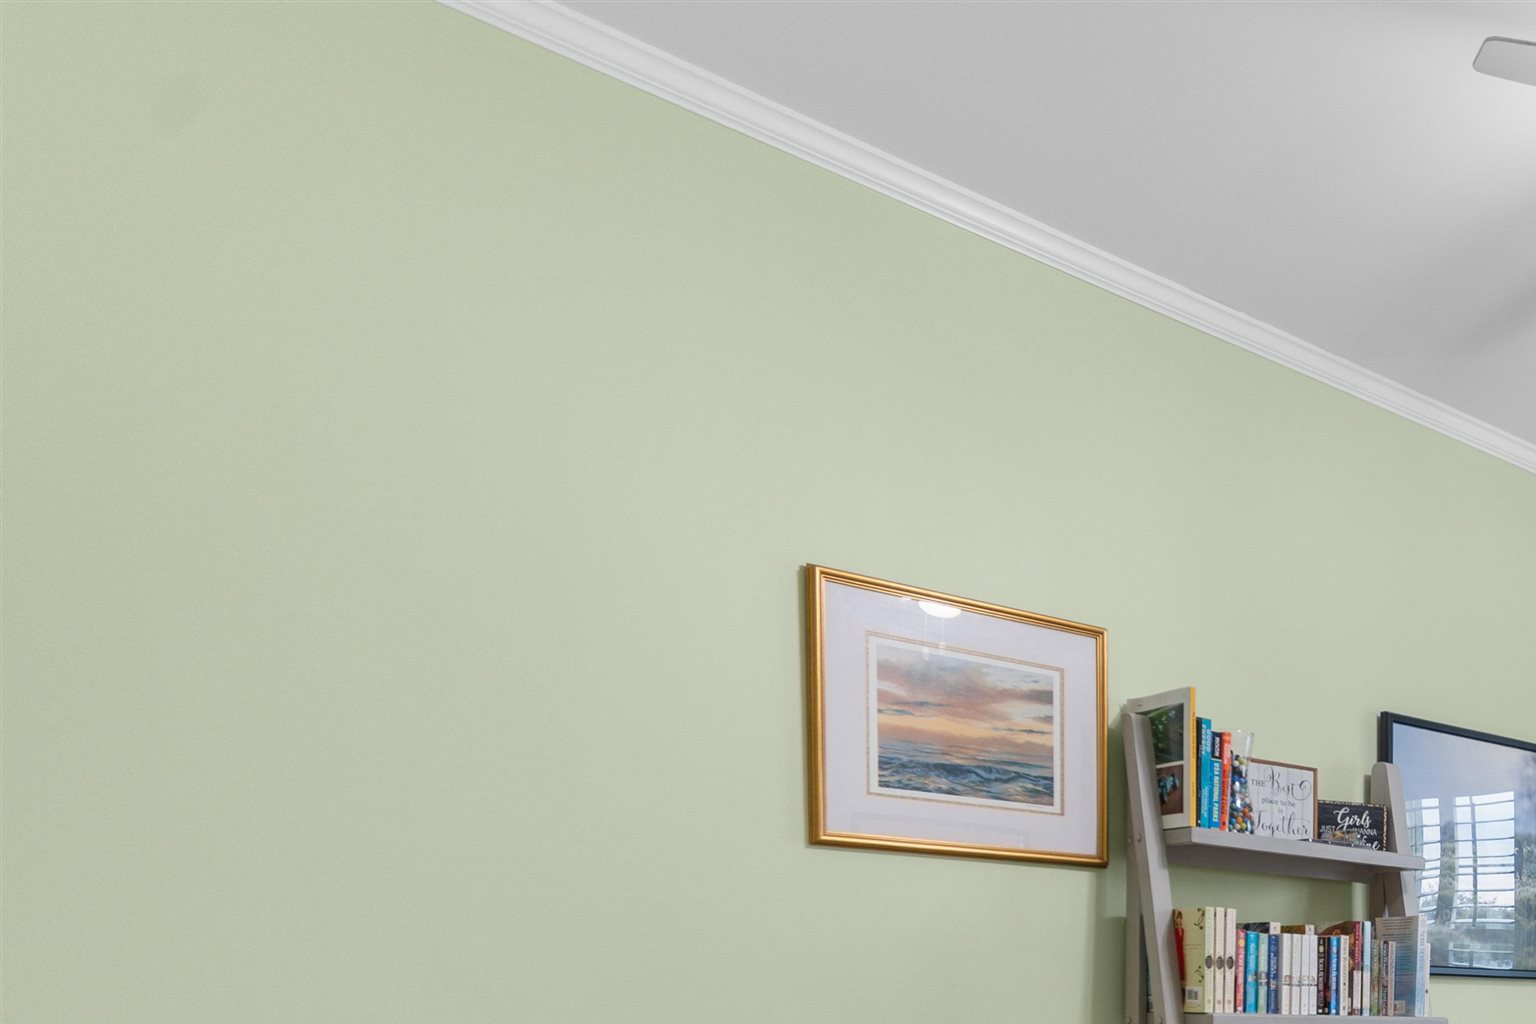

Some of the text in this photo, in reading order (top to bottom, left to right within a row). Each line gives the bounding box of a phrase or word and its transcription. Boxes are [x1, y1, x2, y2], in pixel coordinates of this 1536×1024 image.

[1212, 776, 1220, 802] NATIONAL
[1251, 779, 1265, 787] THE
[1261, 796, 1279, 805] place
[1254, 809, 1312, 837] Together
[1332, 807, 1372, 831] Girls
[1319, 824, 1336, 832] JUST
[1360, 835, 1381, 851] ine
